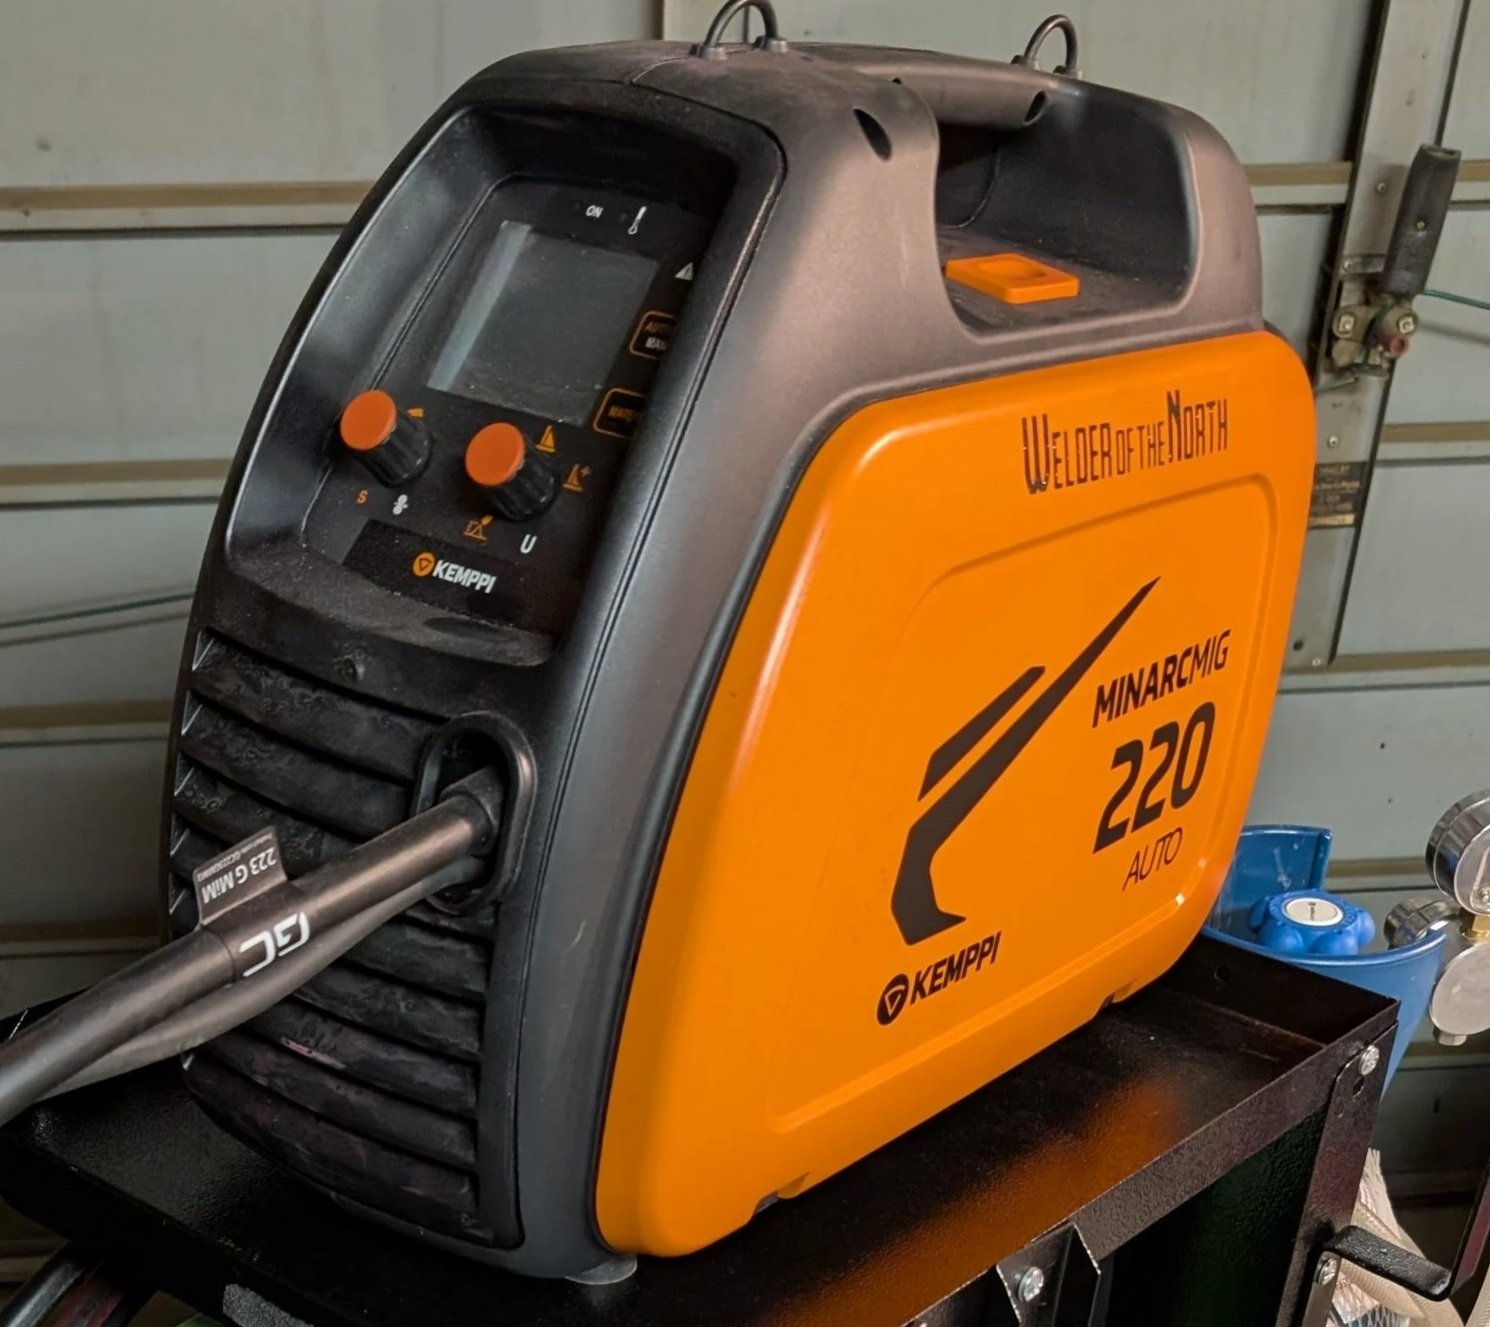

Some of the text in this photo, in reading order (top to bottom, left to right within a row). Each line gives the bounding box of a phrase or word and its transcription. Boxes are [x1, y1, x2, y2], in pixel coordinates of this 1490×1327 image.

[586, 205, 603, 218] ON
[519, 534, 538, 554] U
[433, 561, 496, 594] KEMPPI
[1092, 629, 1231, 729] MINARCMIG
[1093, 701, 1215, 854] 220
[234, 864, 249, 884] G
[249, 846, 277, 875] 223
[1121, 826, 1183, 892] AUTO
[240, 911, 310, 977] GC
[910, 930, 1001, 1006] KEMPPI
